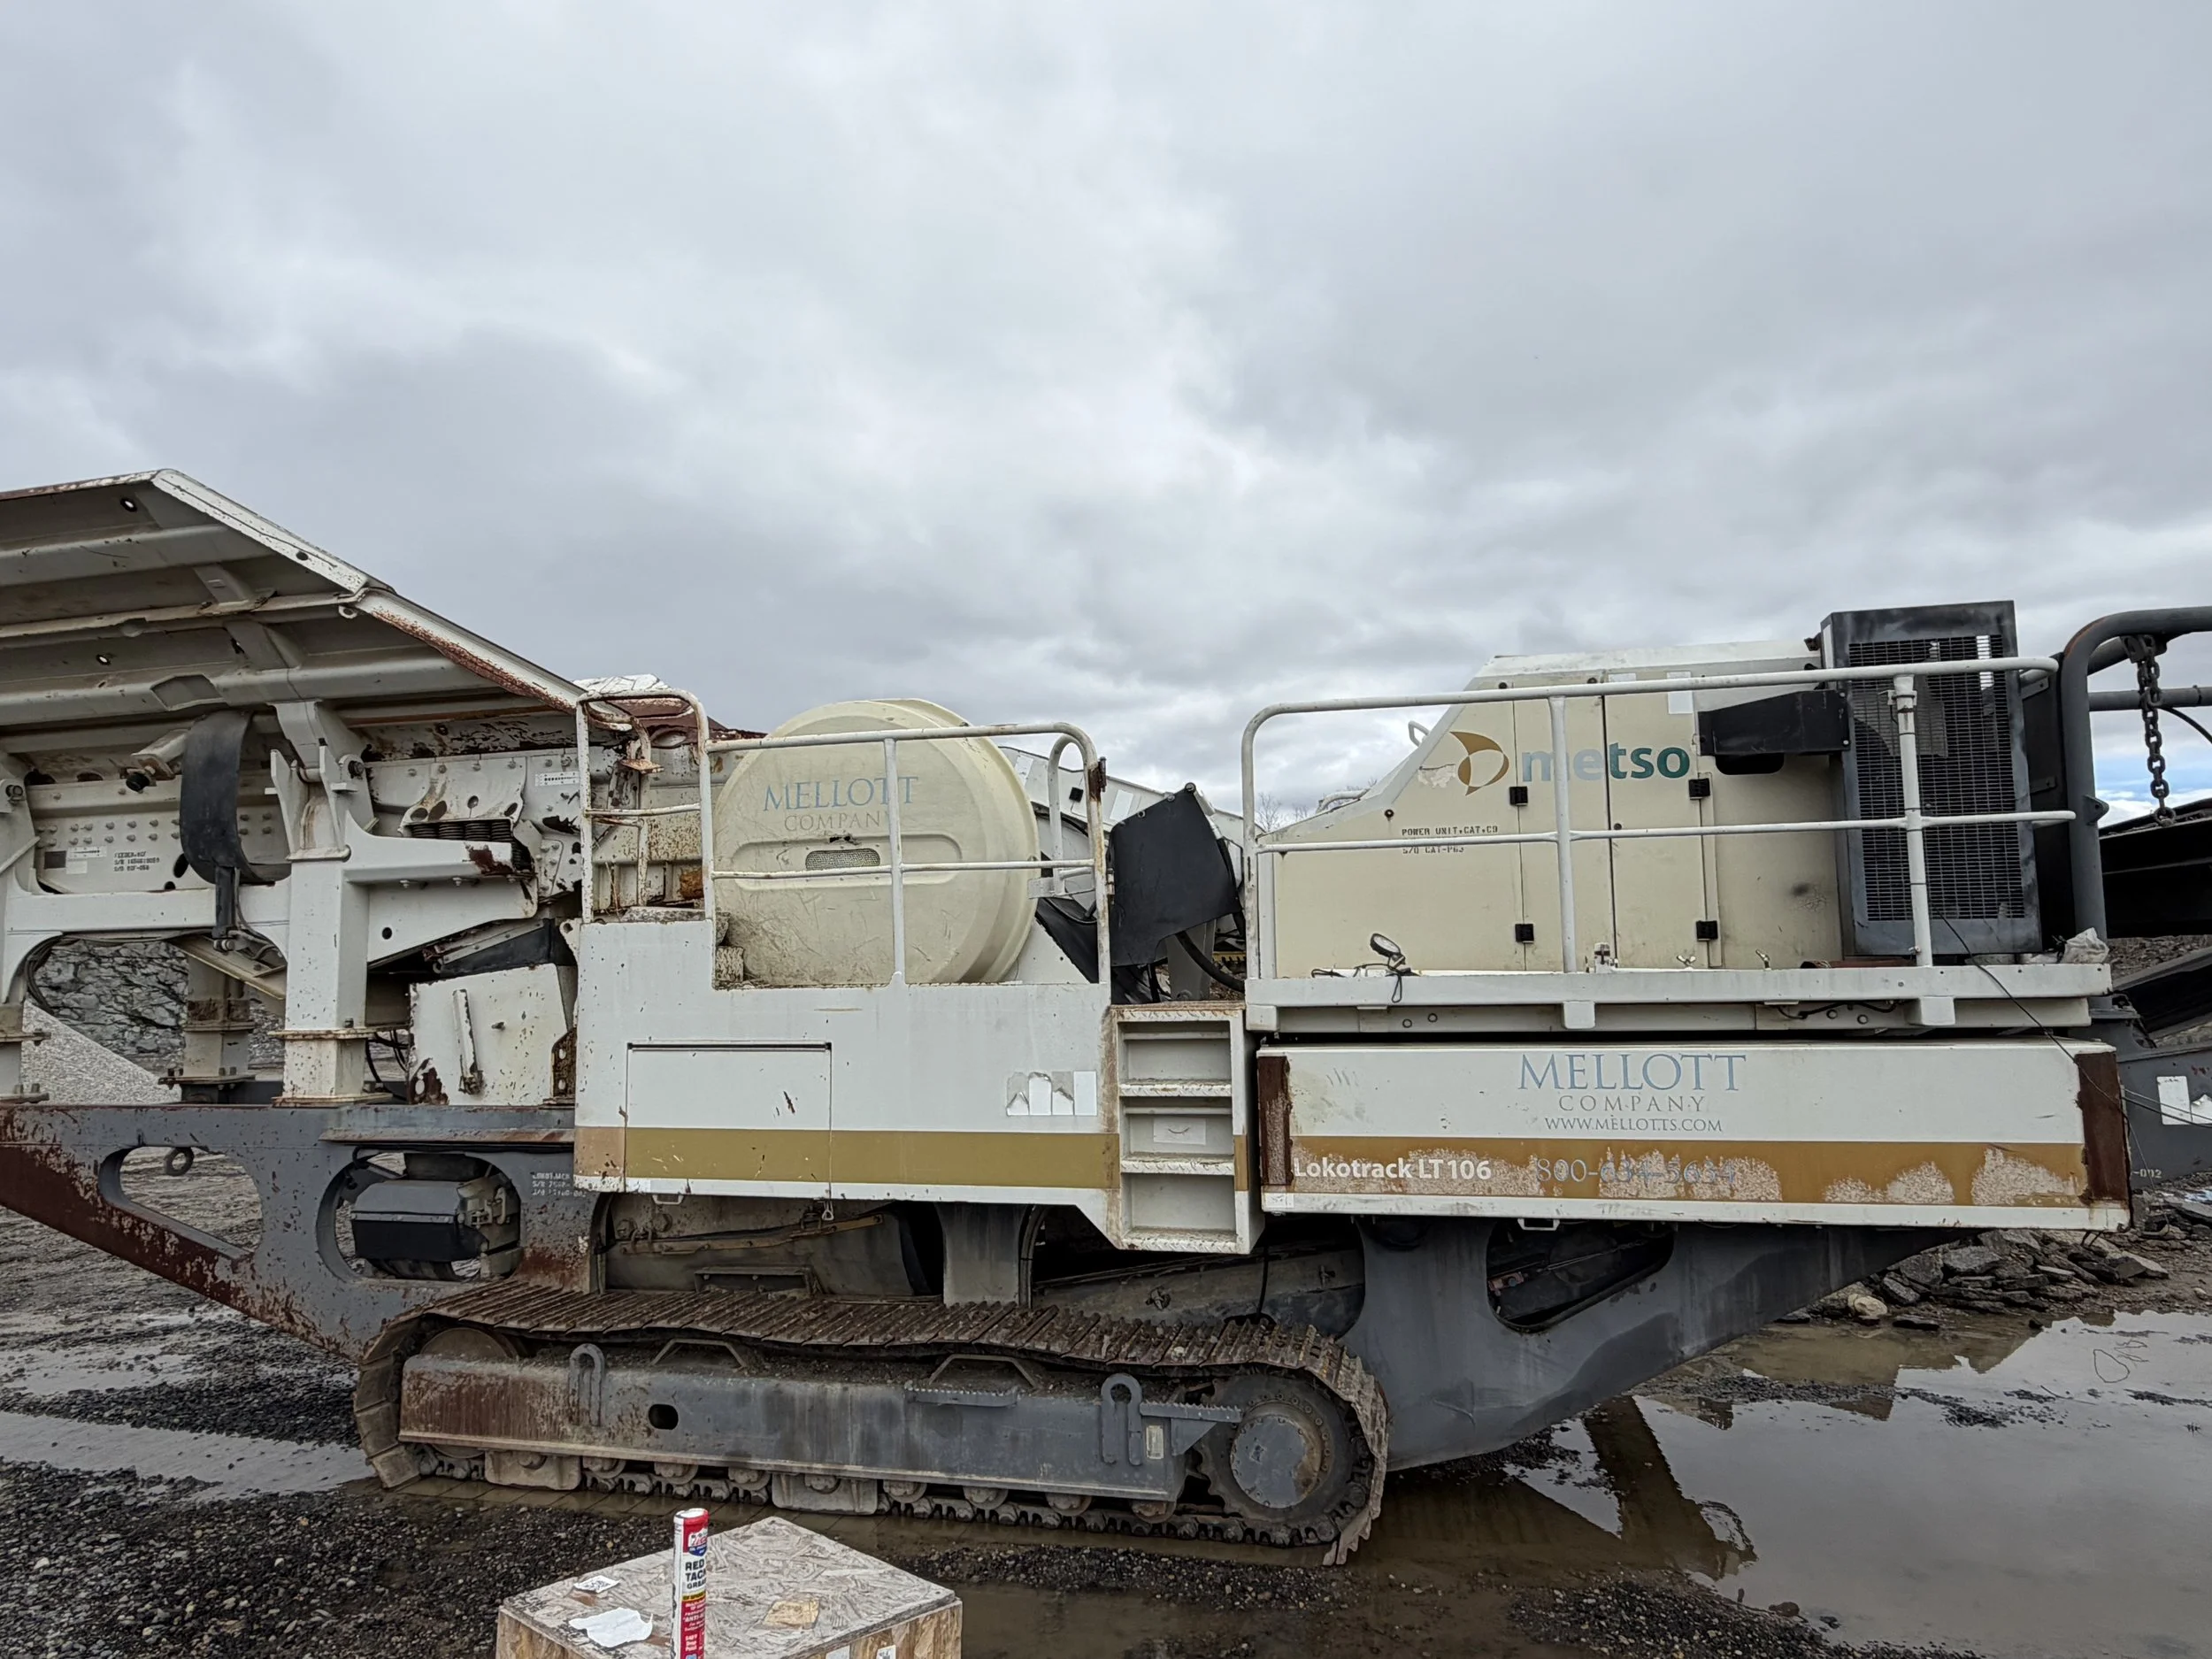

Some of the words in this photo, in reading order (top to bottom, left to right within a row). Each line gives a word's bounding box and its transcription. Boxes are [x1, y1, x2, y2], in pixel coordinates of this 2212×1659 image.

[1522, 742, 1690, 782] metso
[763, 776, 918, 811] MELLOTT
[784, 810, 890, 832] COMPAN
[1402, 827, 1430, 836] POWER
[1517, 1053, 1746, 1091] MELLOTT
[1558, 1095, 1705, 1111] COMPANY
[1545, 1118, 1723, 1132] WWW.MELLOTTS.COM
[1294, 1157, 1414, 1179] Lokotrack
[1418, 1159, 1443, 1179] LT
[1448, 1160, 1492, 1179] 106
[685, 1559, 705, 1571] RED
